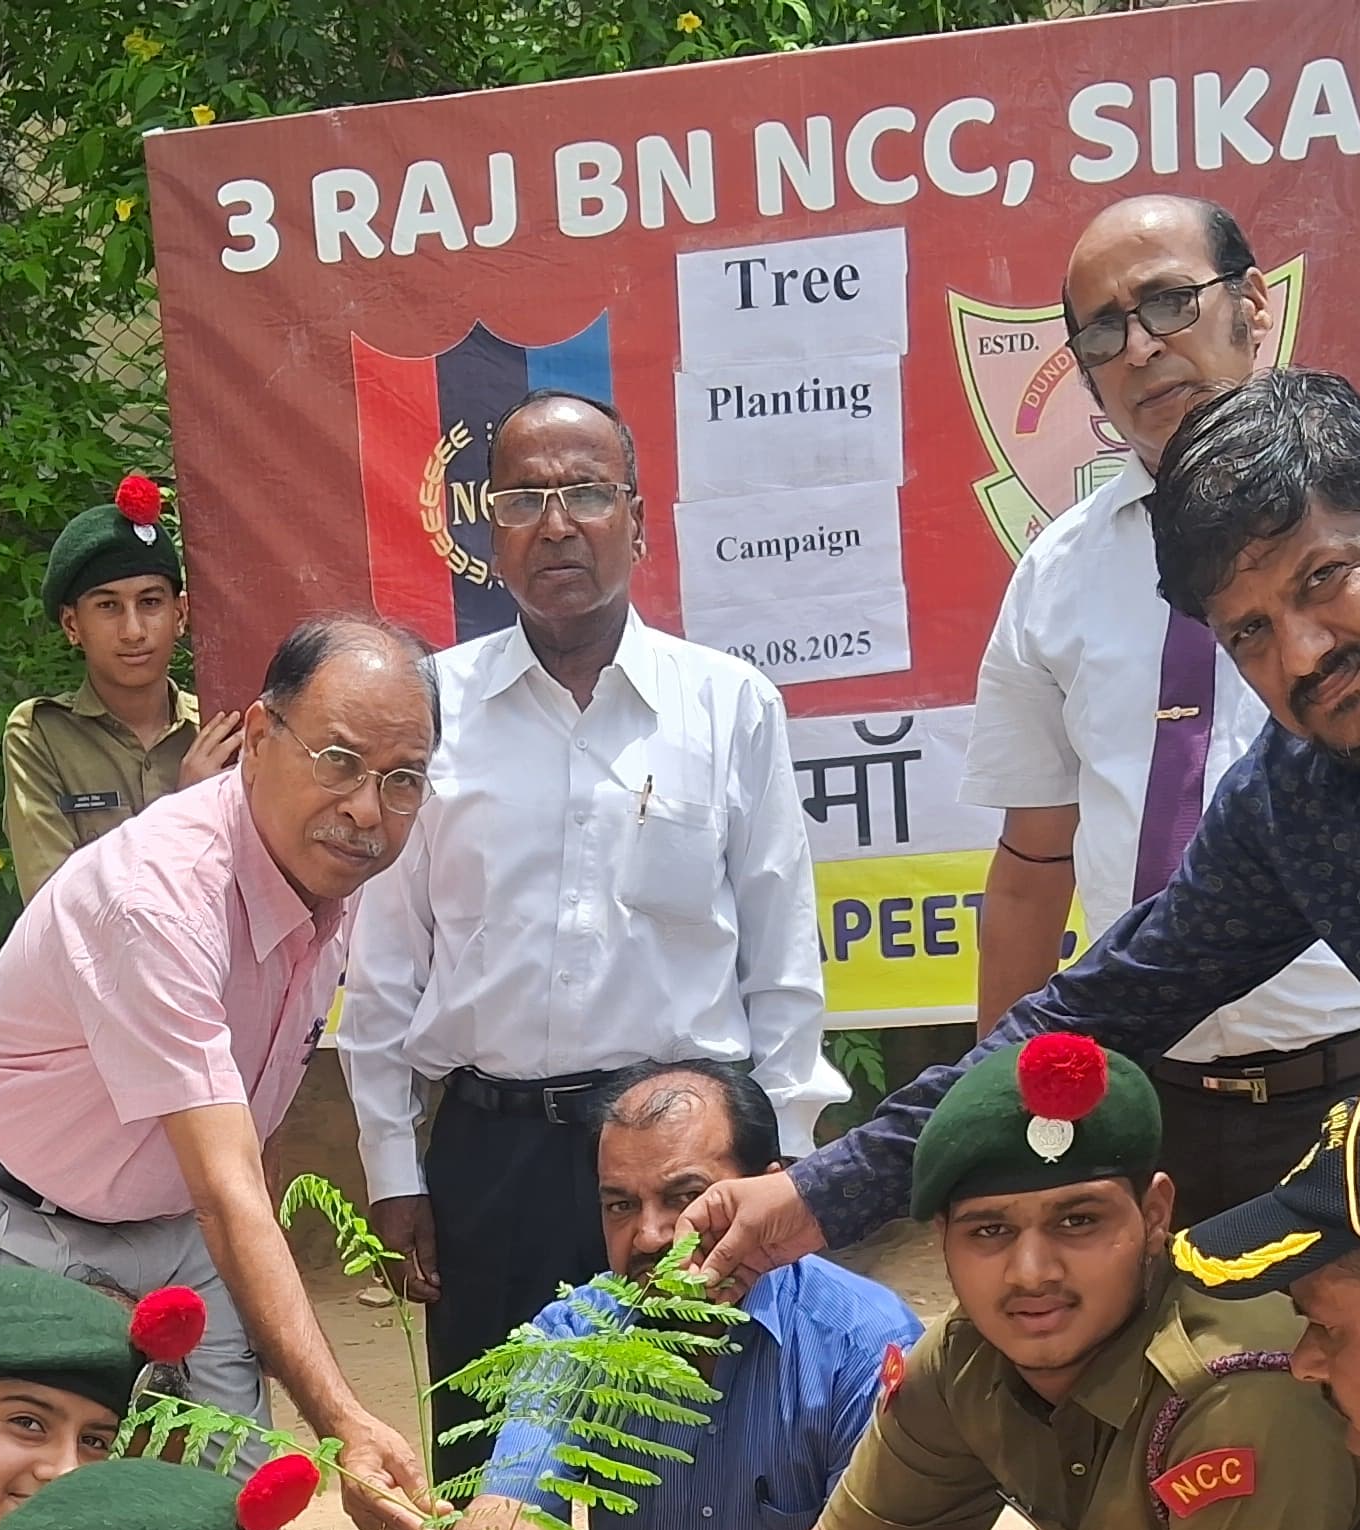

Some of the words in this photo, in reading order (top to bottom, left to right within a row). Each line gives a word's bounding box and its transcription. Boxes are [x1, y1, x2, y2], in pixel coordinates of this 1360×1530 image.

[217, 178, 280, 273] 3
[311, 151, 518, 264] RAJ
[554, 128, 717, 239] BN
[753, 96, 1036, 217] NCC,
[724, 257, 862, 311] Tree
[979, 333, 1040, 355] ESTD.
[706, 378, 873, 422] Planting
[715, 525, 862, 563] Campaign
[1171, 1457, 1242, 1504] NCC
